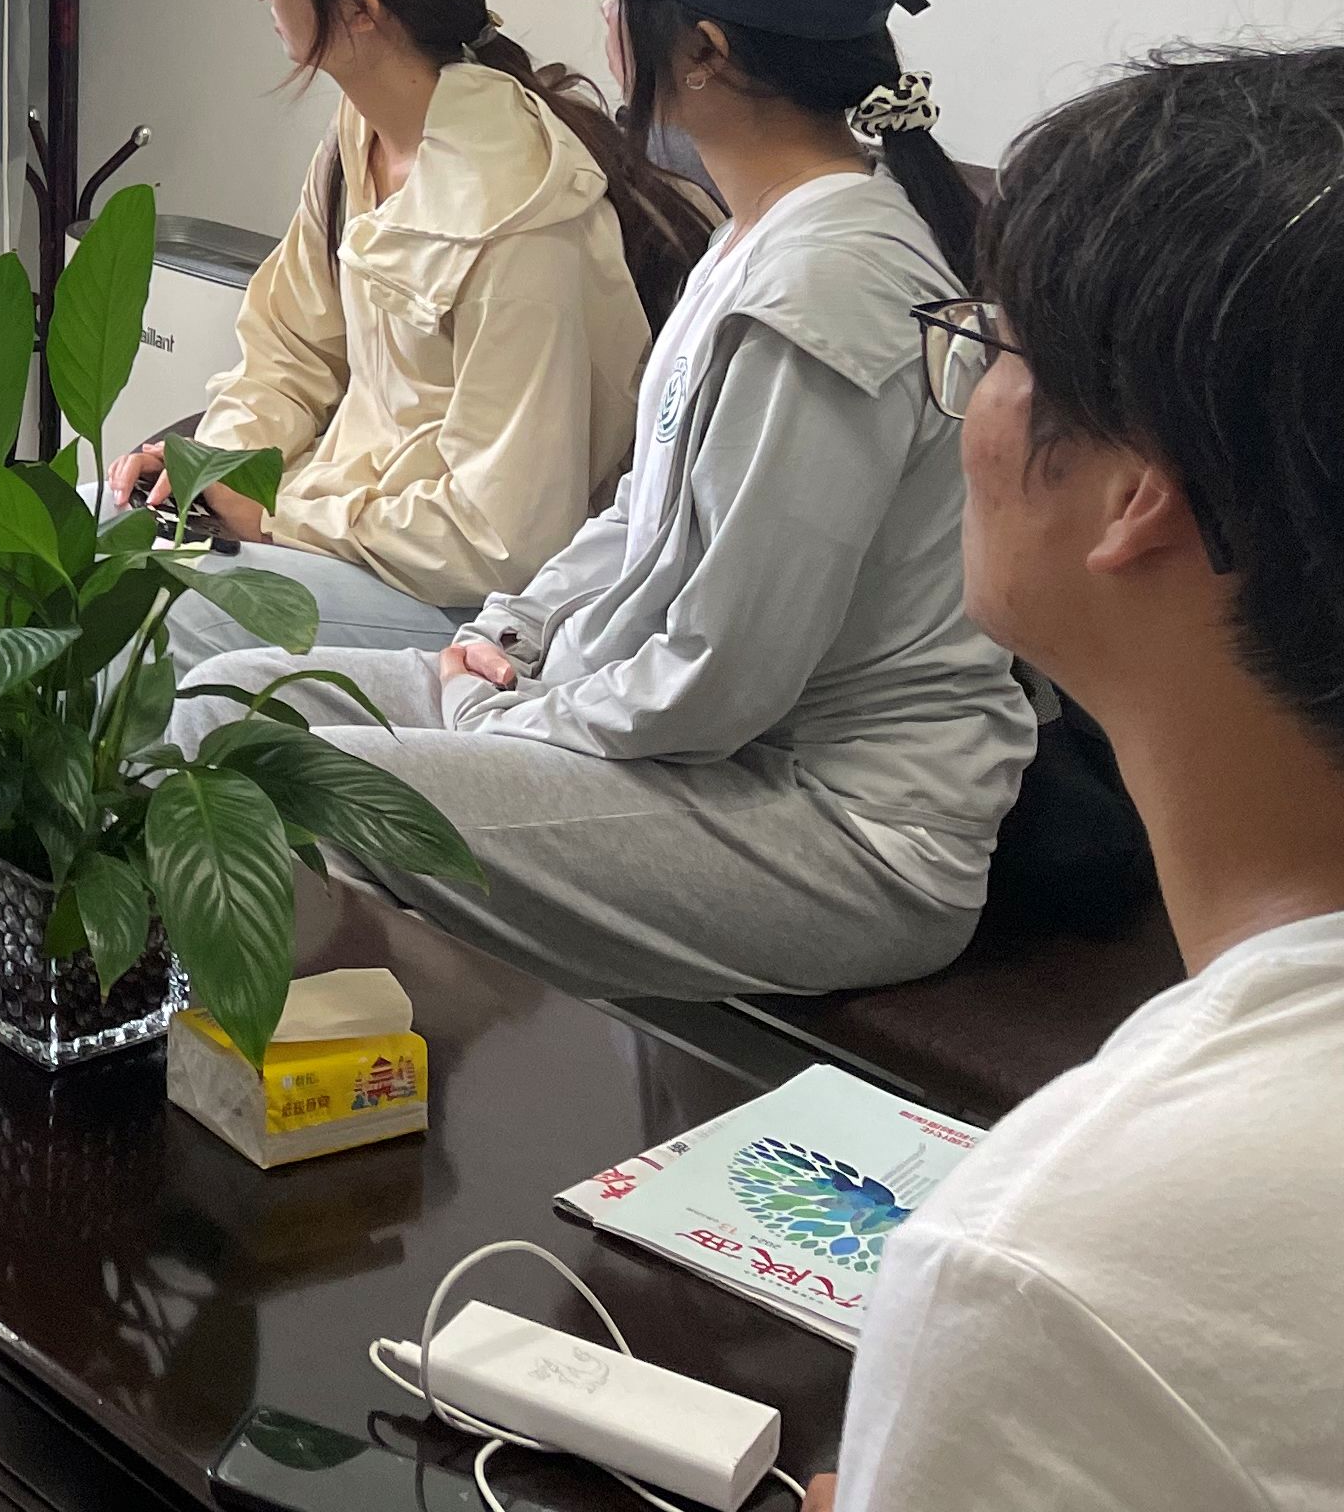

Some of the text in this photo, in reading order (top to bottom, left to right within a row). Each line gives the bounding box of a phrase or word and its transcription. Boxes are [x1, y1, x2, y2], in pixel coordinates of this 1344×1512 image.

[141, 327, 175, 353] aillant
[675, 1229, 867, 1310] 代陕西
